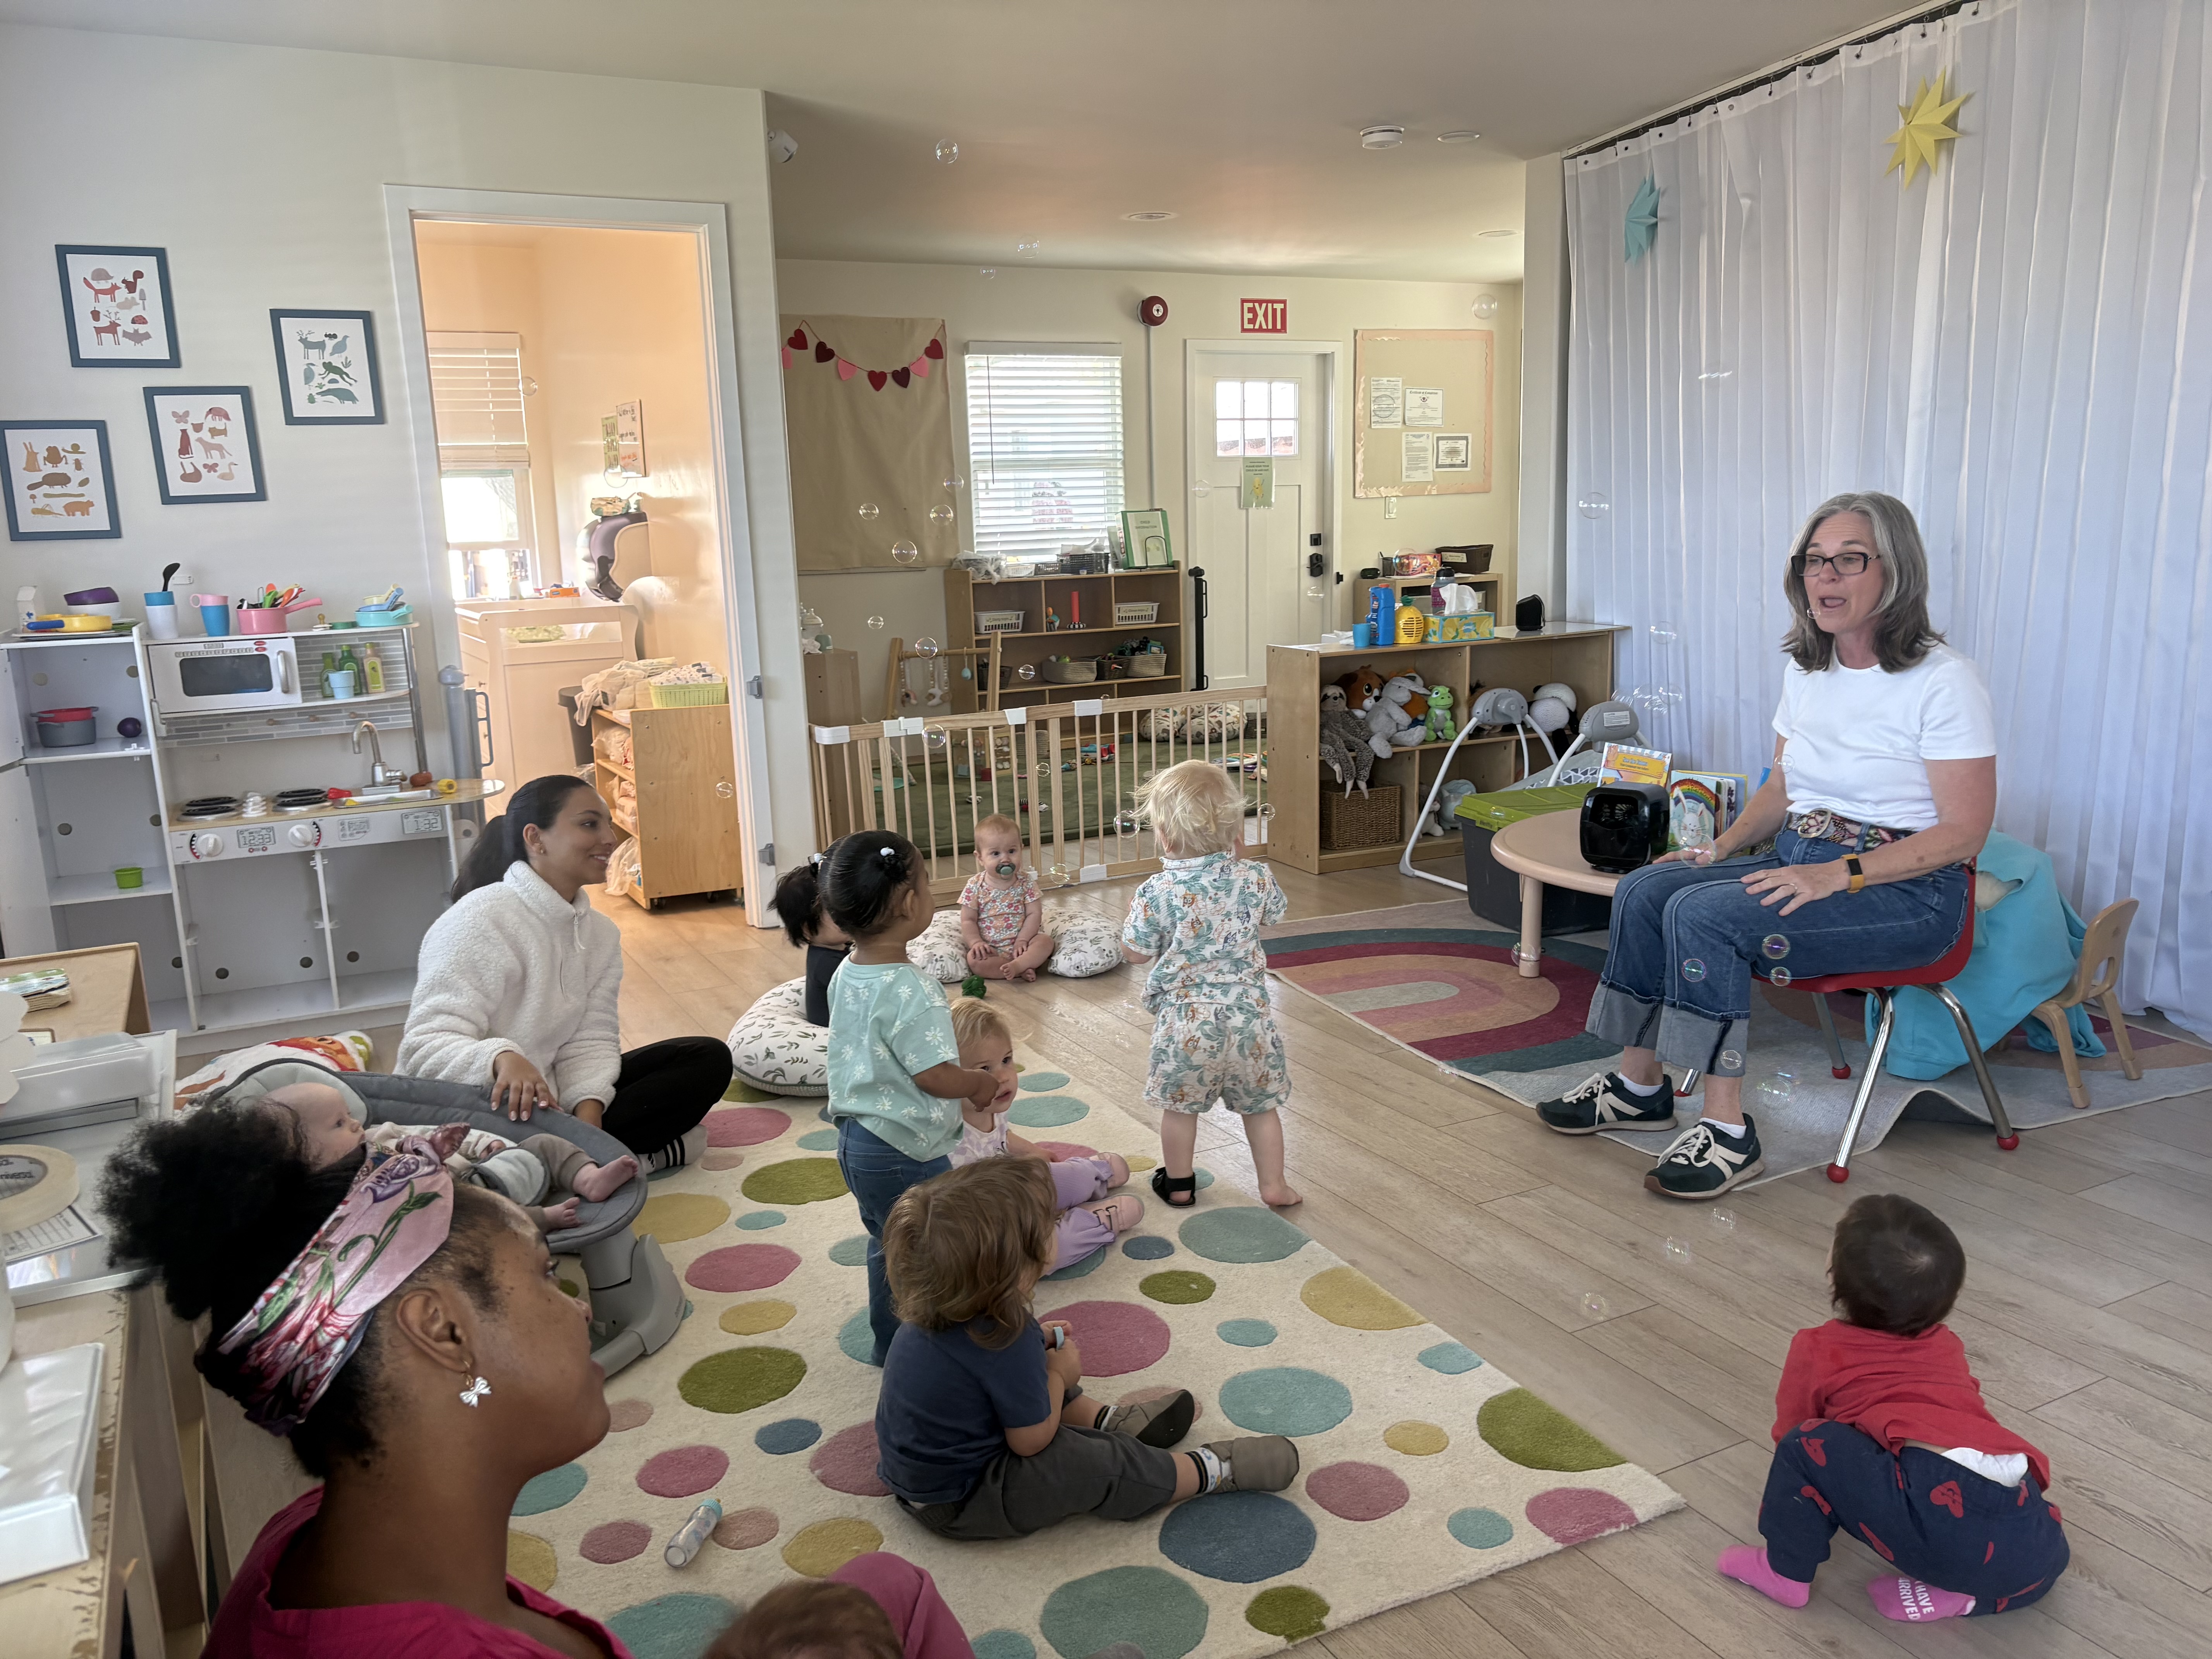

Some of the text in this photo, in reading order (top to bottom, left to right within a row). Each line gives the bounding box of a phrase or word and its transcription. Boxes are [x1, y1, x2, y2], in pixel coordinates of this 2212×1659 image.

[1243, 302, 1285, 330] EXIT
[414, 817, 438, 830] 1:32
[242, 833, 272, 845] 12:33
[1915, 1585, 1935, 1614] HAVE
